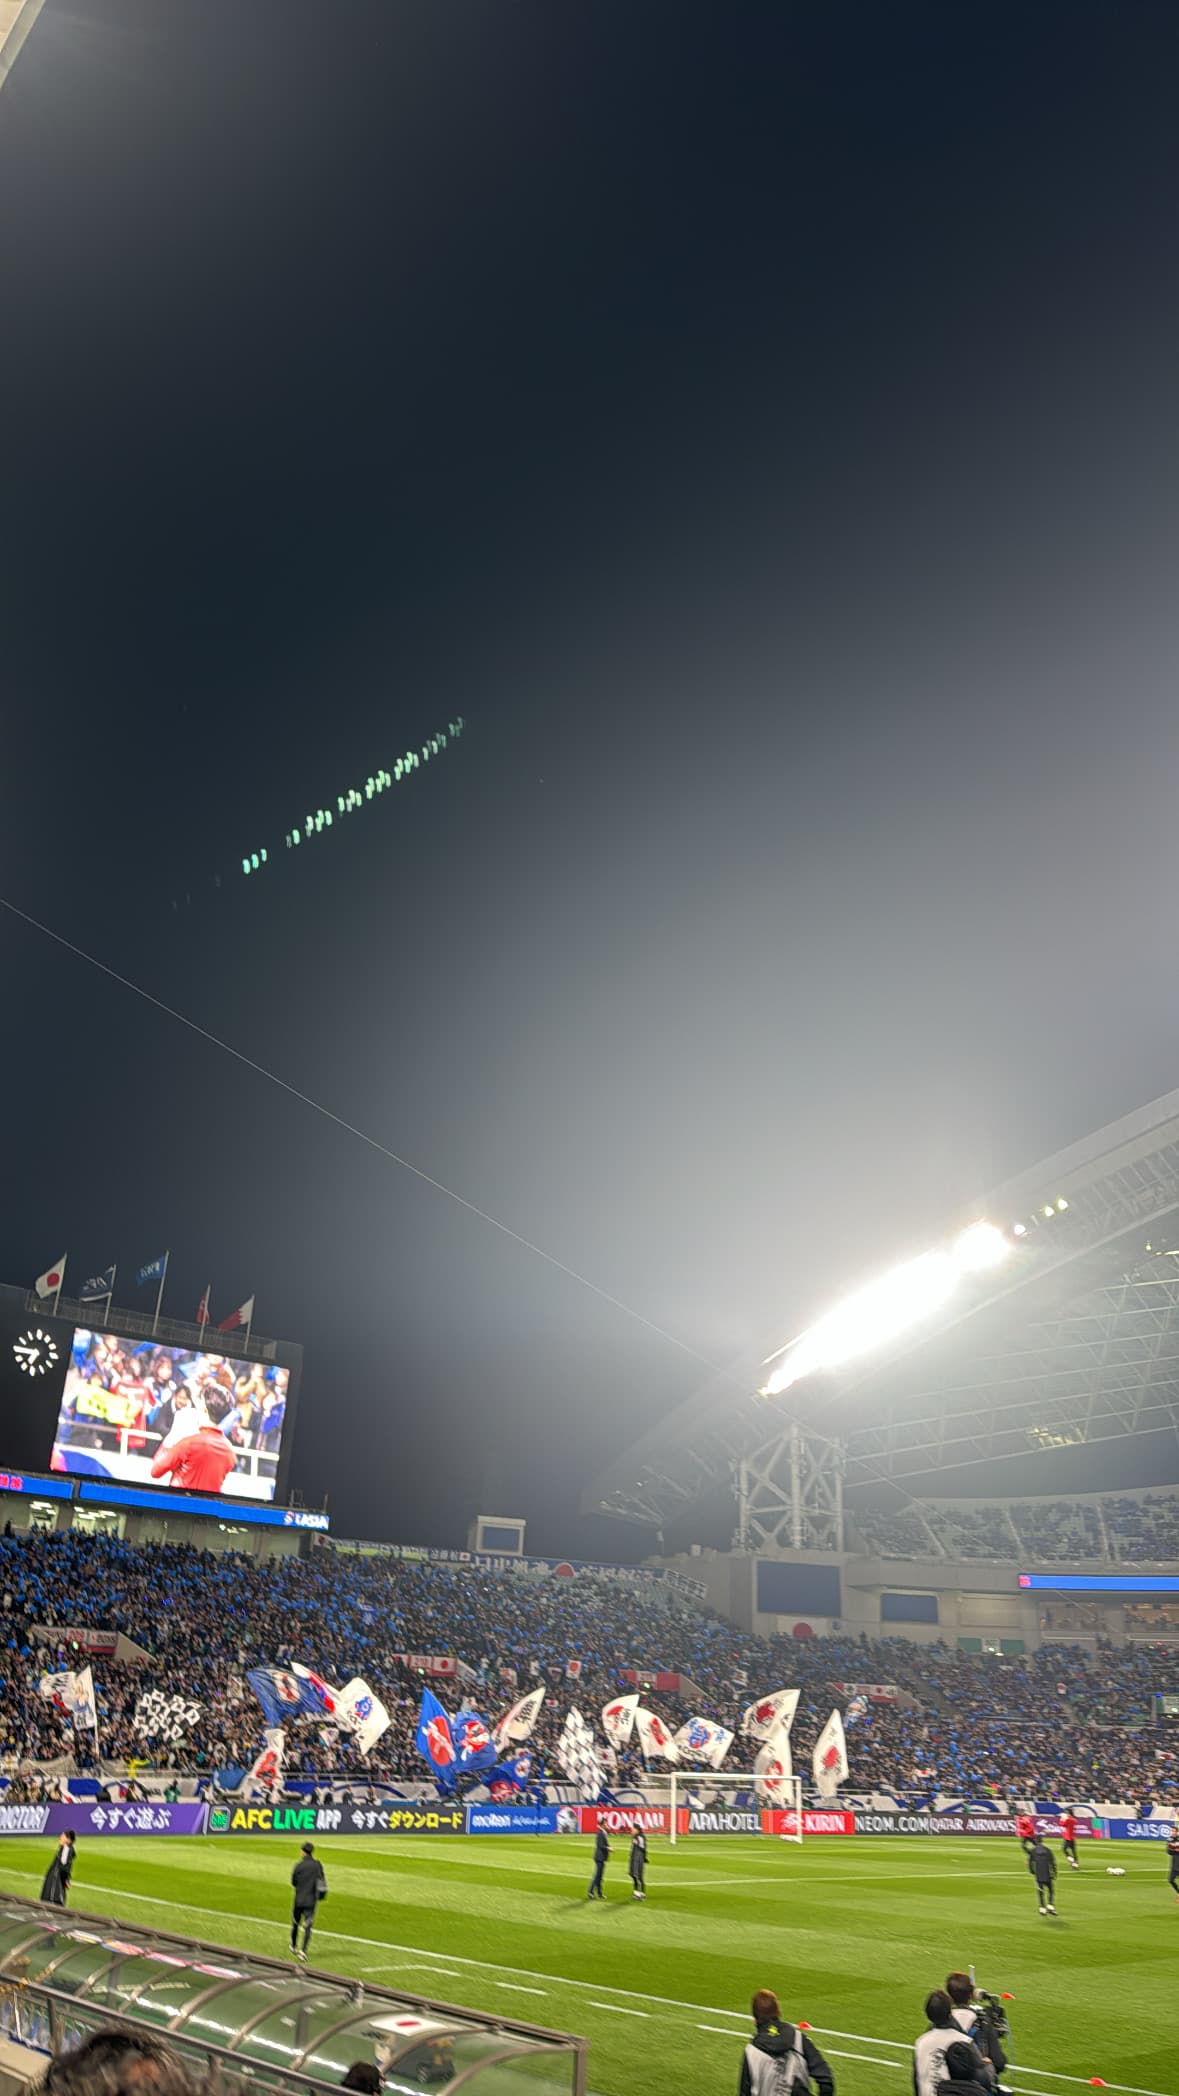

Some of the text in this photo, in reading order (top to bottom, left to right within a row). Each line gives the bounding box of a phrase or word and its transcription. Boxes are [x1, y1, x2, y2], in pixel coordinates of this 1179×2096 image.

[90, 1806, 172, 1830] 今すぐ遊ぶ
[231, 1808, 272, 1830] AFC
[273, 1809, 316, 1830] LIVE
[804, 1814, 845, 1832] KIRIN
[855, 1815, 929, 1832] NEOM.COM
[930, 1817, 964, 1833] QATAR
[965, 1818, 1016, 1833] AIRWAYS
